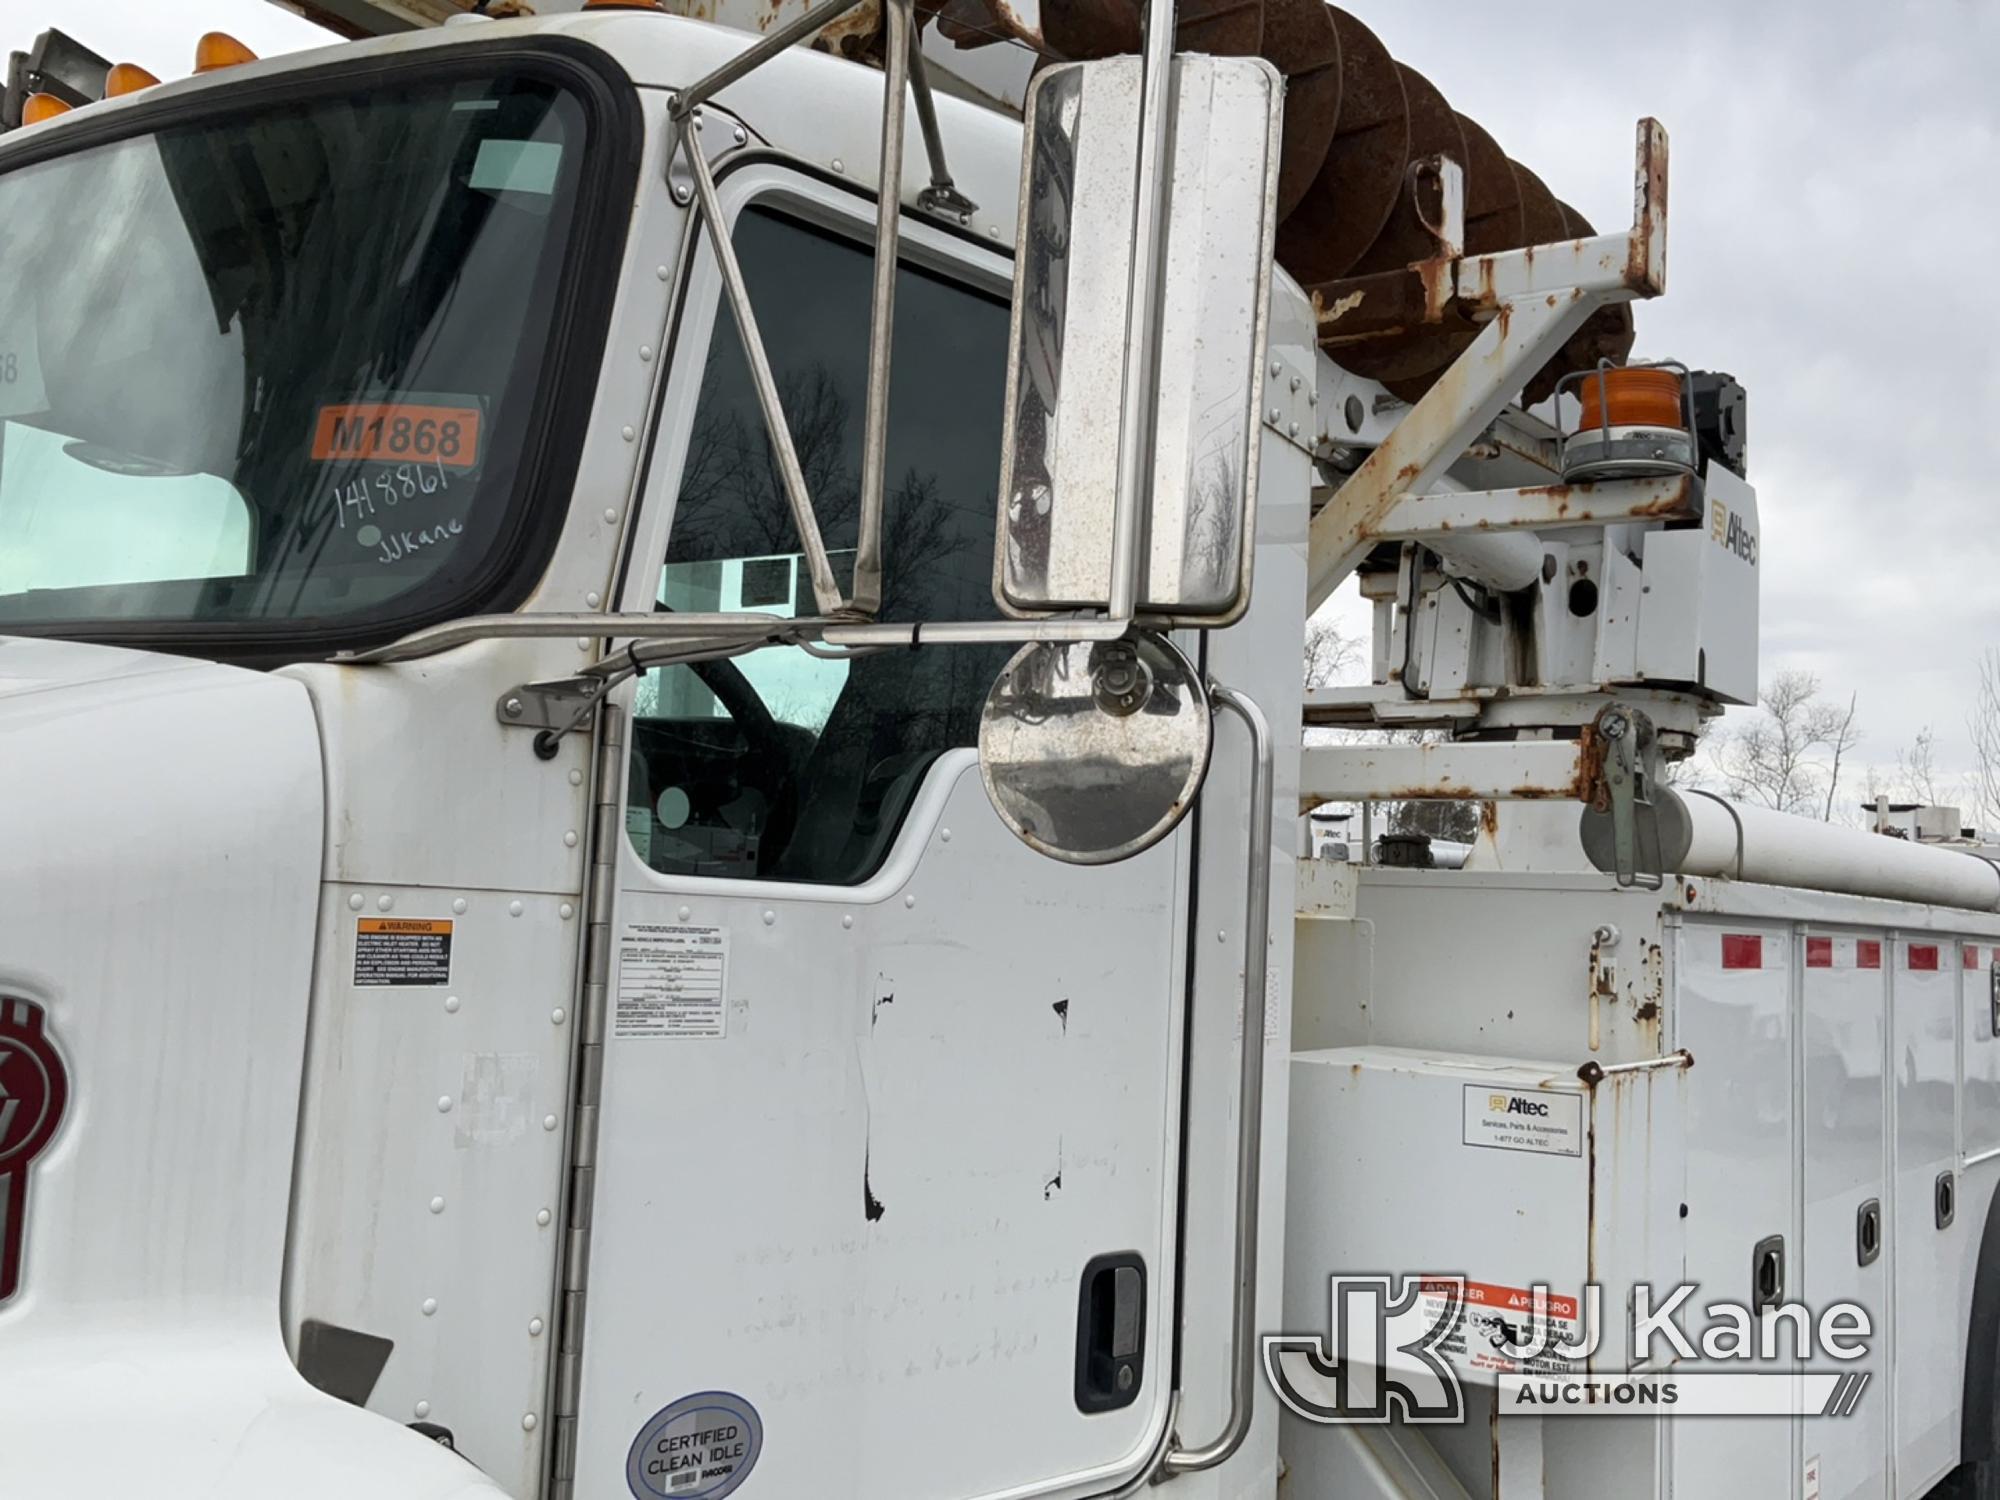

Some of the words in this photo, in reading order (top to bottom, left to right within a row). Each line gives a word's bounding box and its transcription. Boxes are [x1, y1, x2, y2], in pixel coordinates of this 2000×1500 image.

[331, 416, 461, 457] M1868
[334, 456, 448, 528] 1418861
[1725, 511, 1756, 566] Altec
[388, 922, 432, 931] WARNING
[1508, 1097, 1548, 1117] Altec
[1510, 1121, 1525, 1130] Parts
[1526, 1123, 1531, 1131] &
[1532, 1124, 1568, 1135] Accessories
[1494, 1135, 1512, 1143] 1-877
[1513, 1137, 1525, 1145] GO
[1526, 1138, 1548, 1147] ALTEC
[1558, 1321, 1568, 1330] SE
[657, 1426, 738, 1454] CERTIFIED
[648, 1452, 702, 1475] CLEAN
[710, 1443, 744, 1462] IDLE
